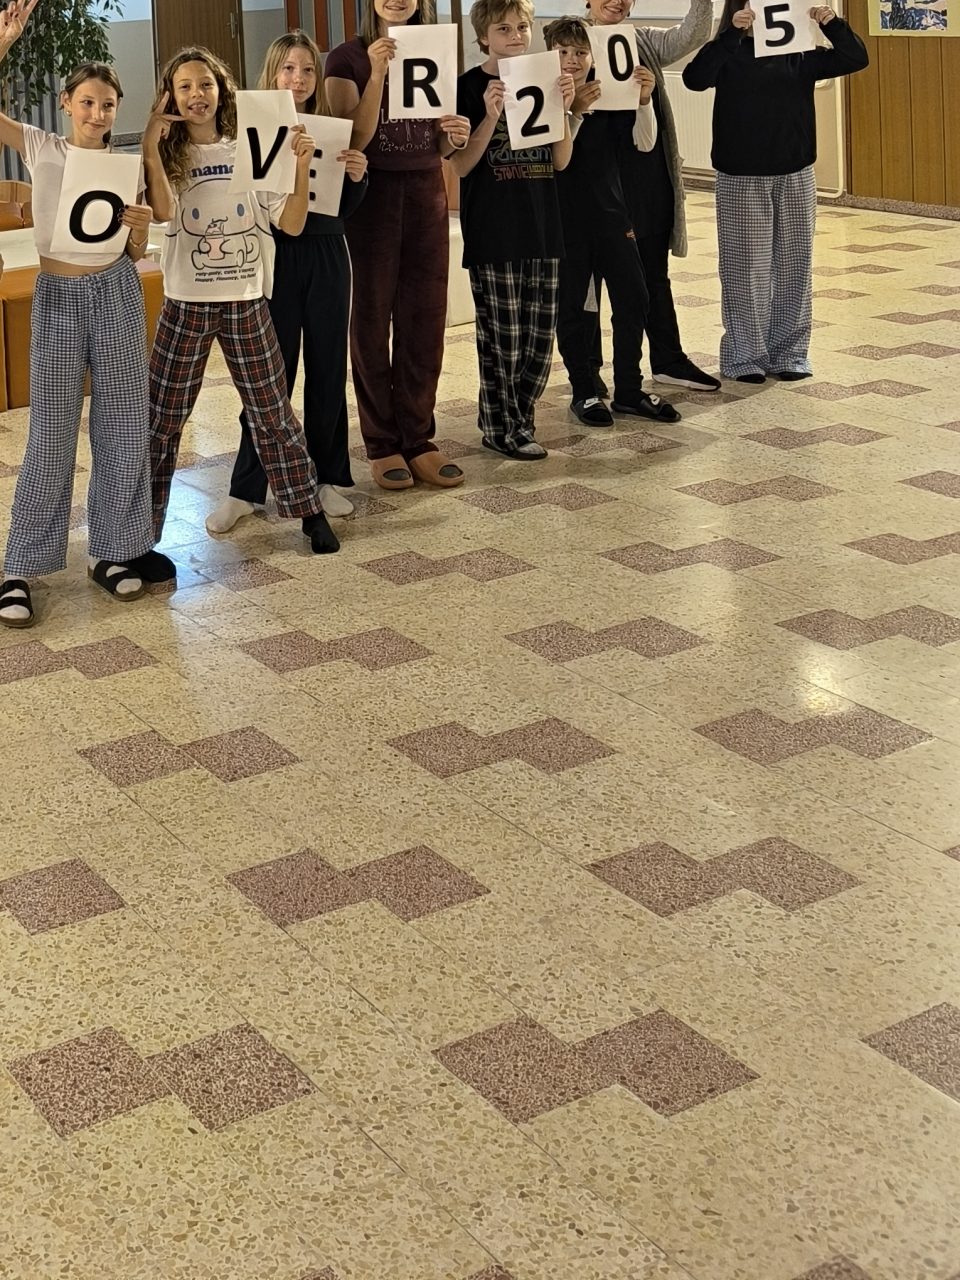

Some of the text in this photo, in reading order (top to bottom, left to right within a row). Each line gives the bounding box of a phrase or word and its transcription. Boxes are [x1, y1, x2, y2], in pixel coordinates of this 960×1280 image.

[763, 3, 795, 48] 5
[402, 57, 442, 108] R
[515, 85, 550, 138] 2
[246, 125, 289, 180] V
